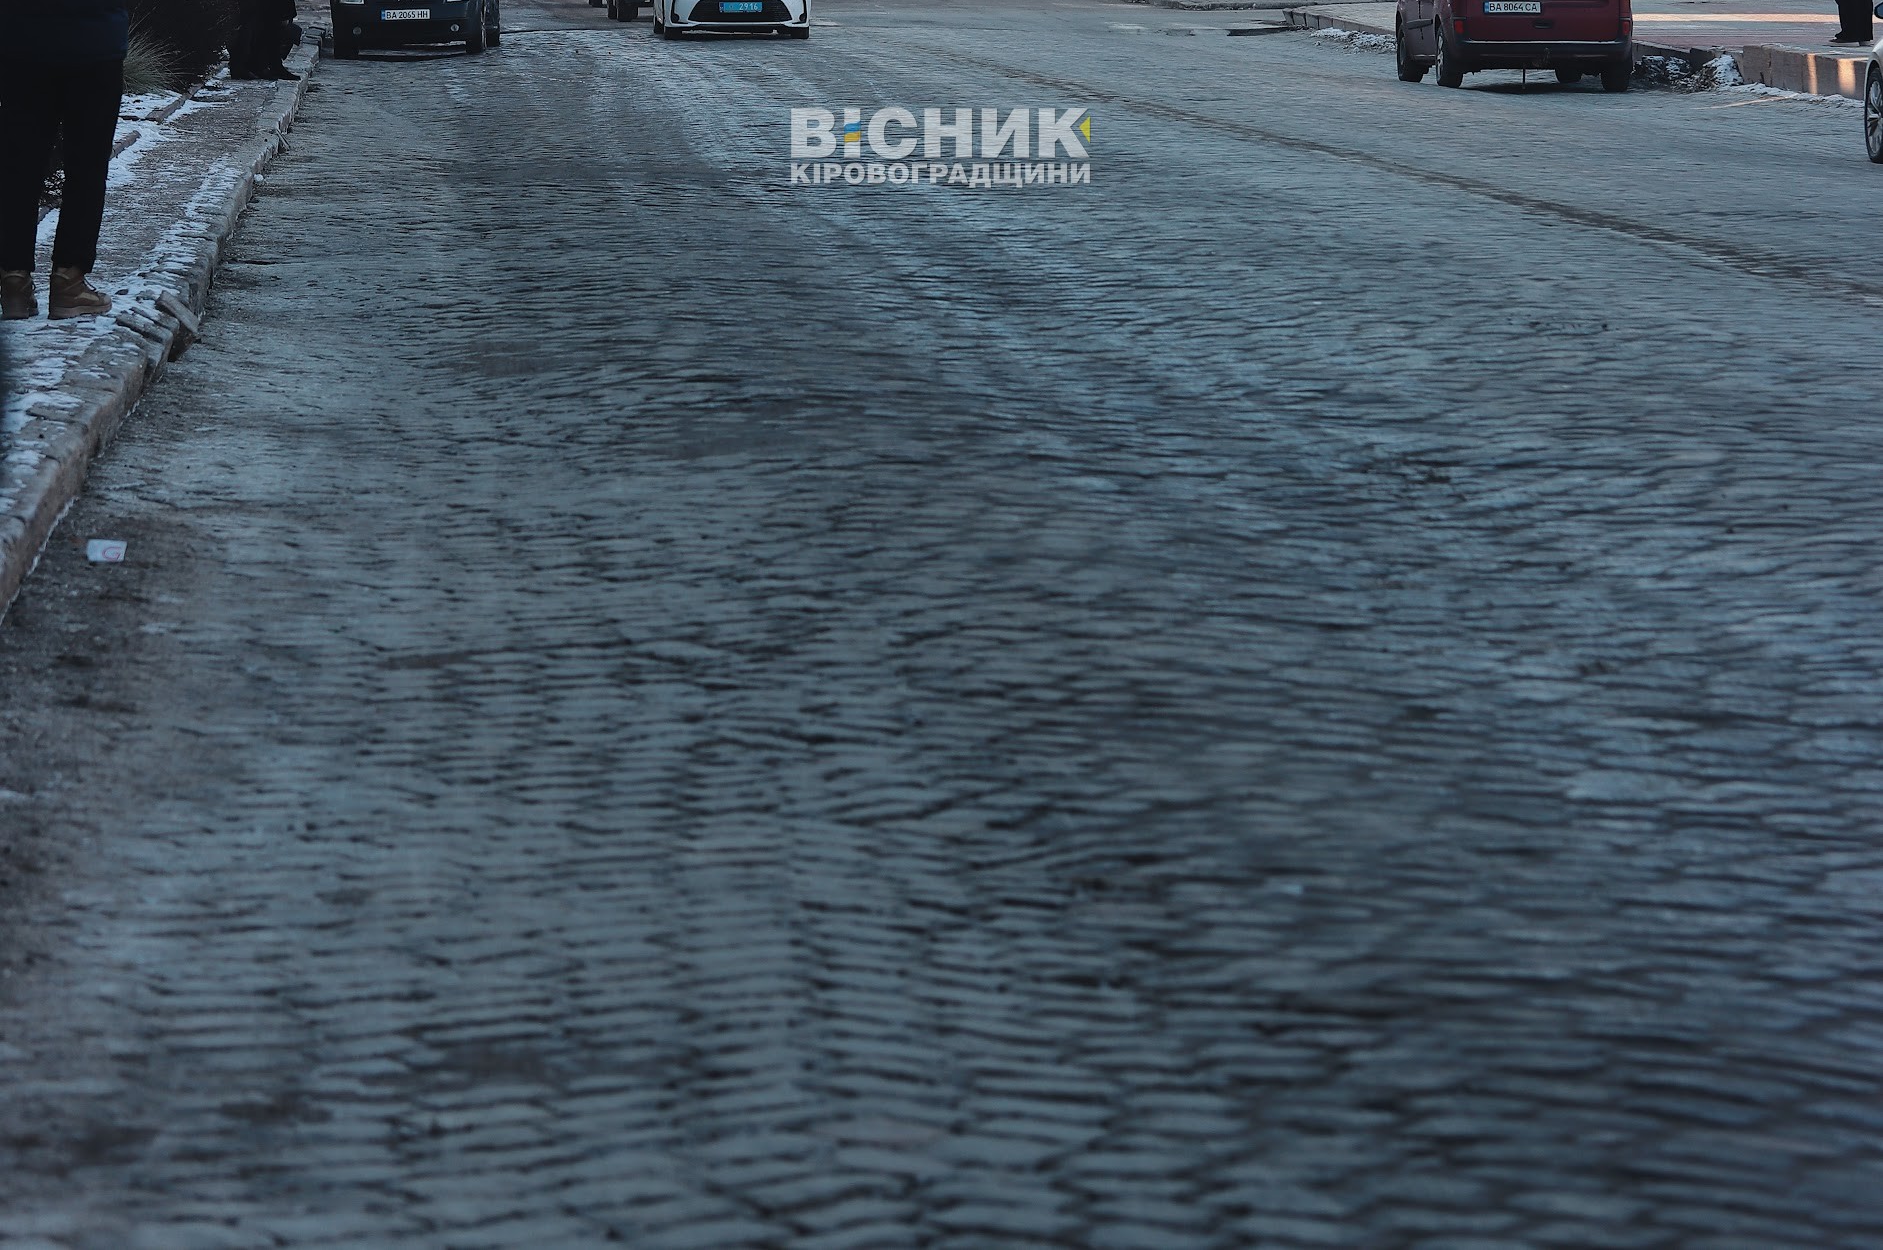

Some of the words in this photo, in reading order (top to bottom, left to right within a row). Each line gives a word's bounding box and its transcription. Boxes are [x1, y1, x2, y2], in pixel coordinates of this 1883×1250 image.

[1489, 3, 1502, 11] BA
[1503, 3, 1524, 11] 8064
[1525, 3, 1538, 11] CA
[417, 10, 428, 18] HH
